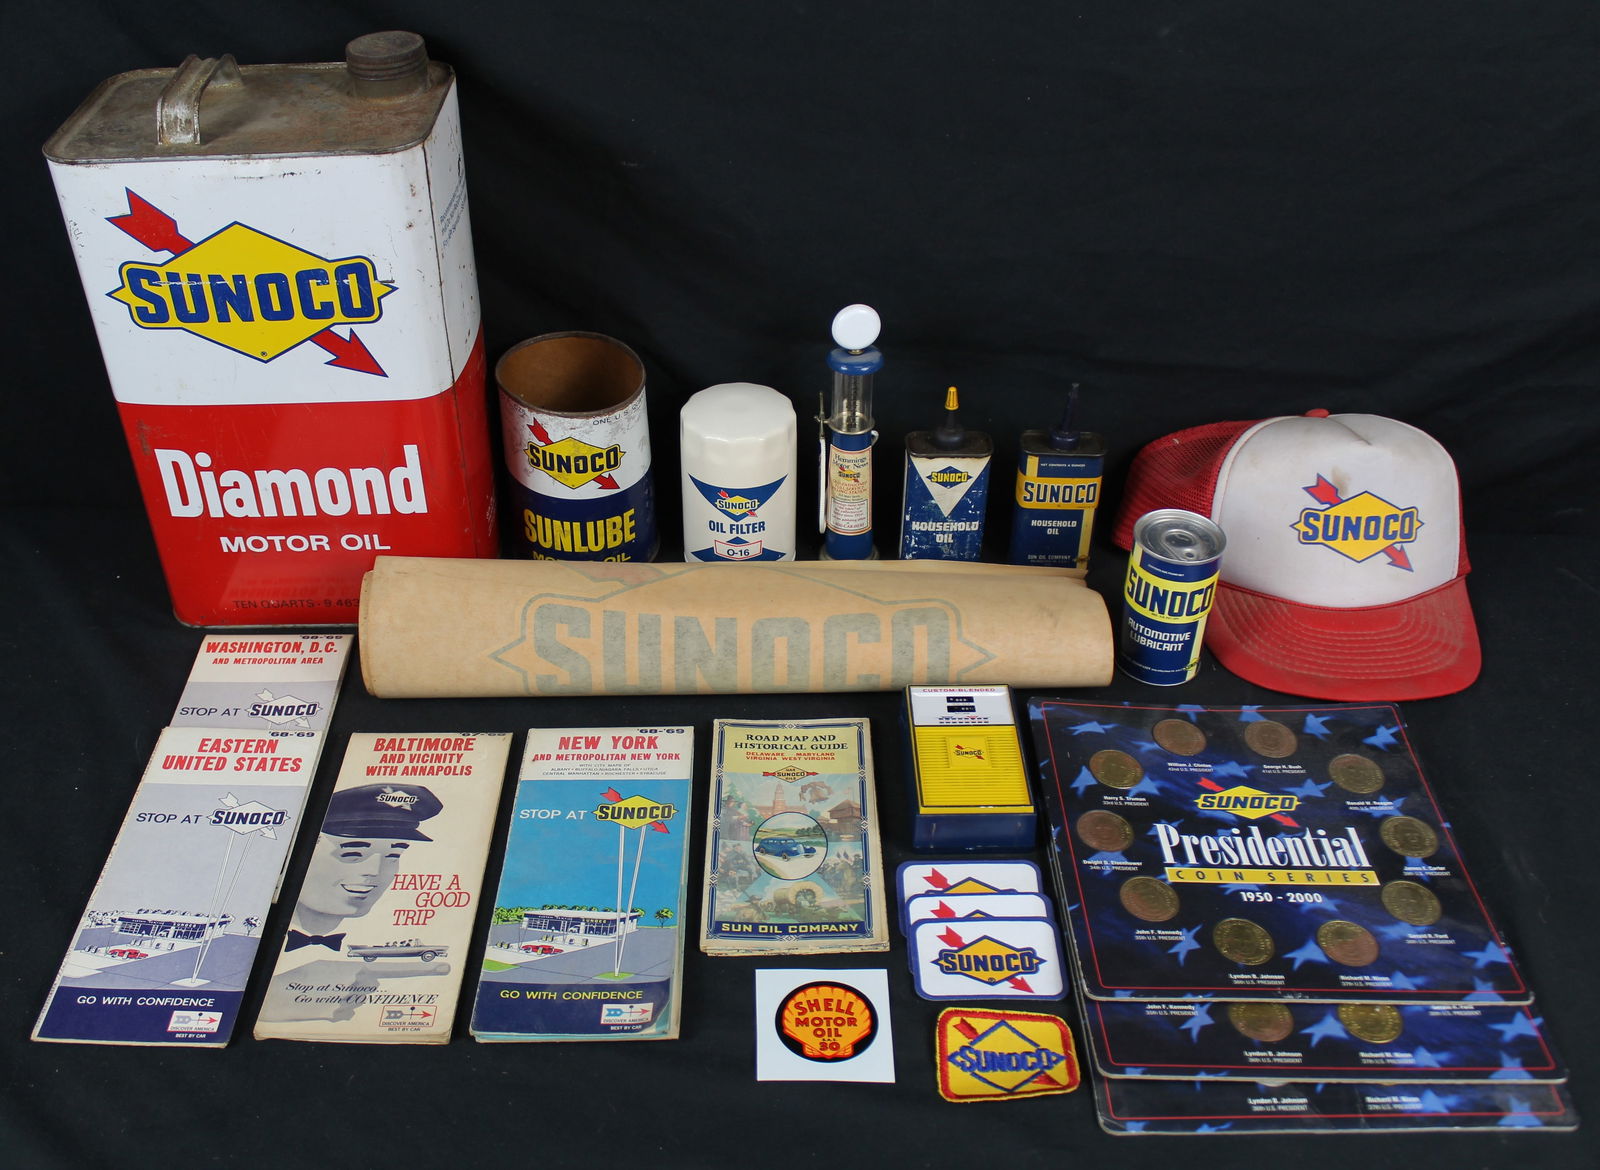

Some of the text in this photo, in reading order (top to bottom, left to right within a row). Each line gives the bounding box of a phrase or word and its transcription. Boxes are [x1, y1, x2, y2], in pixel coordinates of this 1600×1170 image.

[126, 262, 375, 324] SUNOCO
[593, 417, 611, 426] ONE
[529, 443, 620, 474] SUNOCO
[154, 444, 428, 518] Diamond
[931, 472, 969, 483] SUNOCO
[1023, 481, 1098, 503] SUNOCO
[717, 499, 759, 511] SUNOCO
[523, 508, 636, 553] SUNLUBE
[709, 521, 766, 535] OIL FILTER
[911, 521, 979, 531] HOUSEHOLD
[1031, 520, 1077, 528] HOUSEHOLD
[1302, 511, 1415, 541] SUNOCO
[220, 534, 391, 553] MOTOR OIL
[935, 533, 954, 543] OIL
[726, 548, 750, 557] O-16
[1127, 566, 1215, 617] SUNOCO
[233, 600, 258, 609] TEN
[261, 599, 315, 609] QUARTS
[1128, 617, 1191, 642] AUTOMOTIVE
[206, 641, 338, 655] WASHINGTON, D.C.
[534, 603, 950, 693] SUNOCO
[1130, 630, 1184, 652] LUBRICANT
[179, 703, 318, 716] STOP AT SUNOCO
[373, 737, 477, 751] BALTIMORE
[558, 736, 660, 750] NEW YORK
[746, 734, 780, 742] ROAD
[197, 738, 279, 754] EASTERN
[734, 742, 848, 750] HISTORICAL GUIDE
[162, 755, 303, 772] UNITED STATES
[379, 753, 463, 764] AND VICINITY
[533, 753, 680, 761] AND METROPOLITAN NEW YORK
[366, 765, 473, 777] WITH ANNAPOLIS
[379, 794, 416, 803] SUNOCO
[1201, 795, 1296, 811] SUNOCO
[136, 810, 286, 825] STOP AT SUNOCO
[519, 805, 673, 820] STOP AT SUNOCO
[1154, 823, 1373, 868] Presidential
[391, 874, 461, 890] HAVE A
[1176, 871, 1370, 883] COIN SERIES
[415, 892, 471, 908] GOOD
[1240, 891, 1323, 903] 1950 2000
[393, 909, 436, 926] TRIP
[721, 923, 859, 933] SUN OIL COMPANY
[943, 952, 1035, 972] SUNOCO
[285, 982, 314, 992] Stop
[317, 984, 331, 992] at
[76, 995, 215, 1007] GO WITH CONFIDENCE
[294, 994, 439, 1005] Go with CONFIDENCE
[500, 990, 643, 1000] GO WITH CONFIDENCE
[793, 998, 855, 1016] SHELL
[795, 1016, 858, 1027] MOTOR
[813, 1028, 842, 1038] OIL
[819, 1042, 841, 1051] 30
[960, 1047, 1051, 1073] SUNOCO
